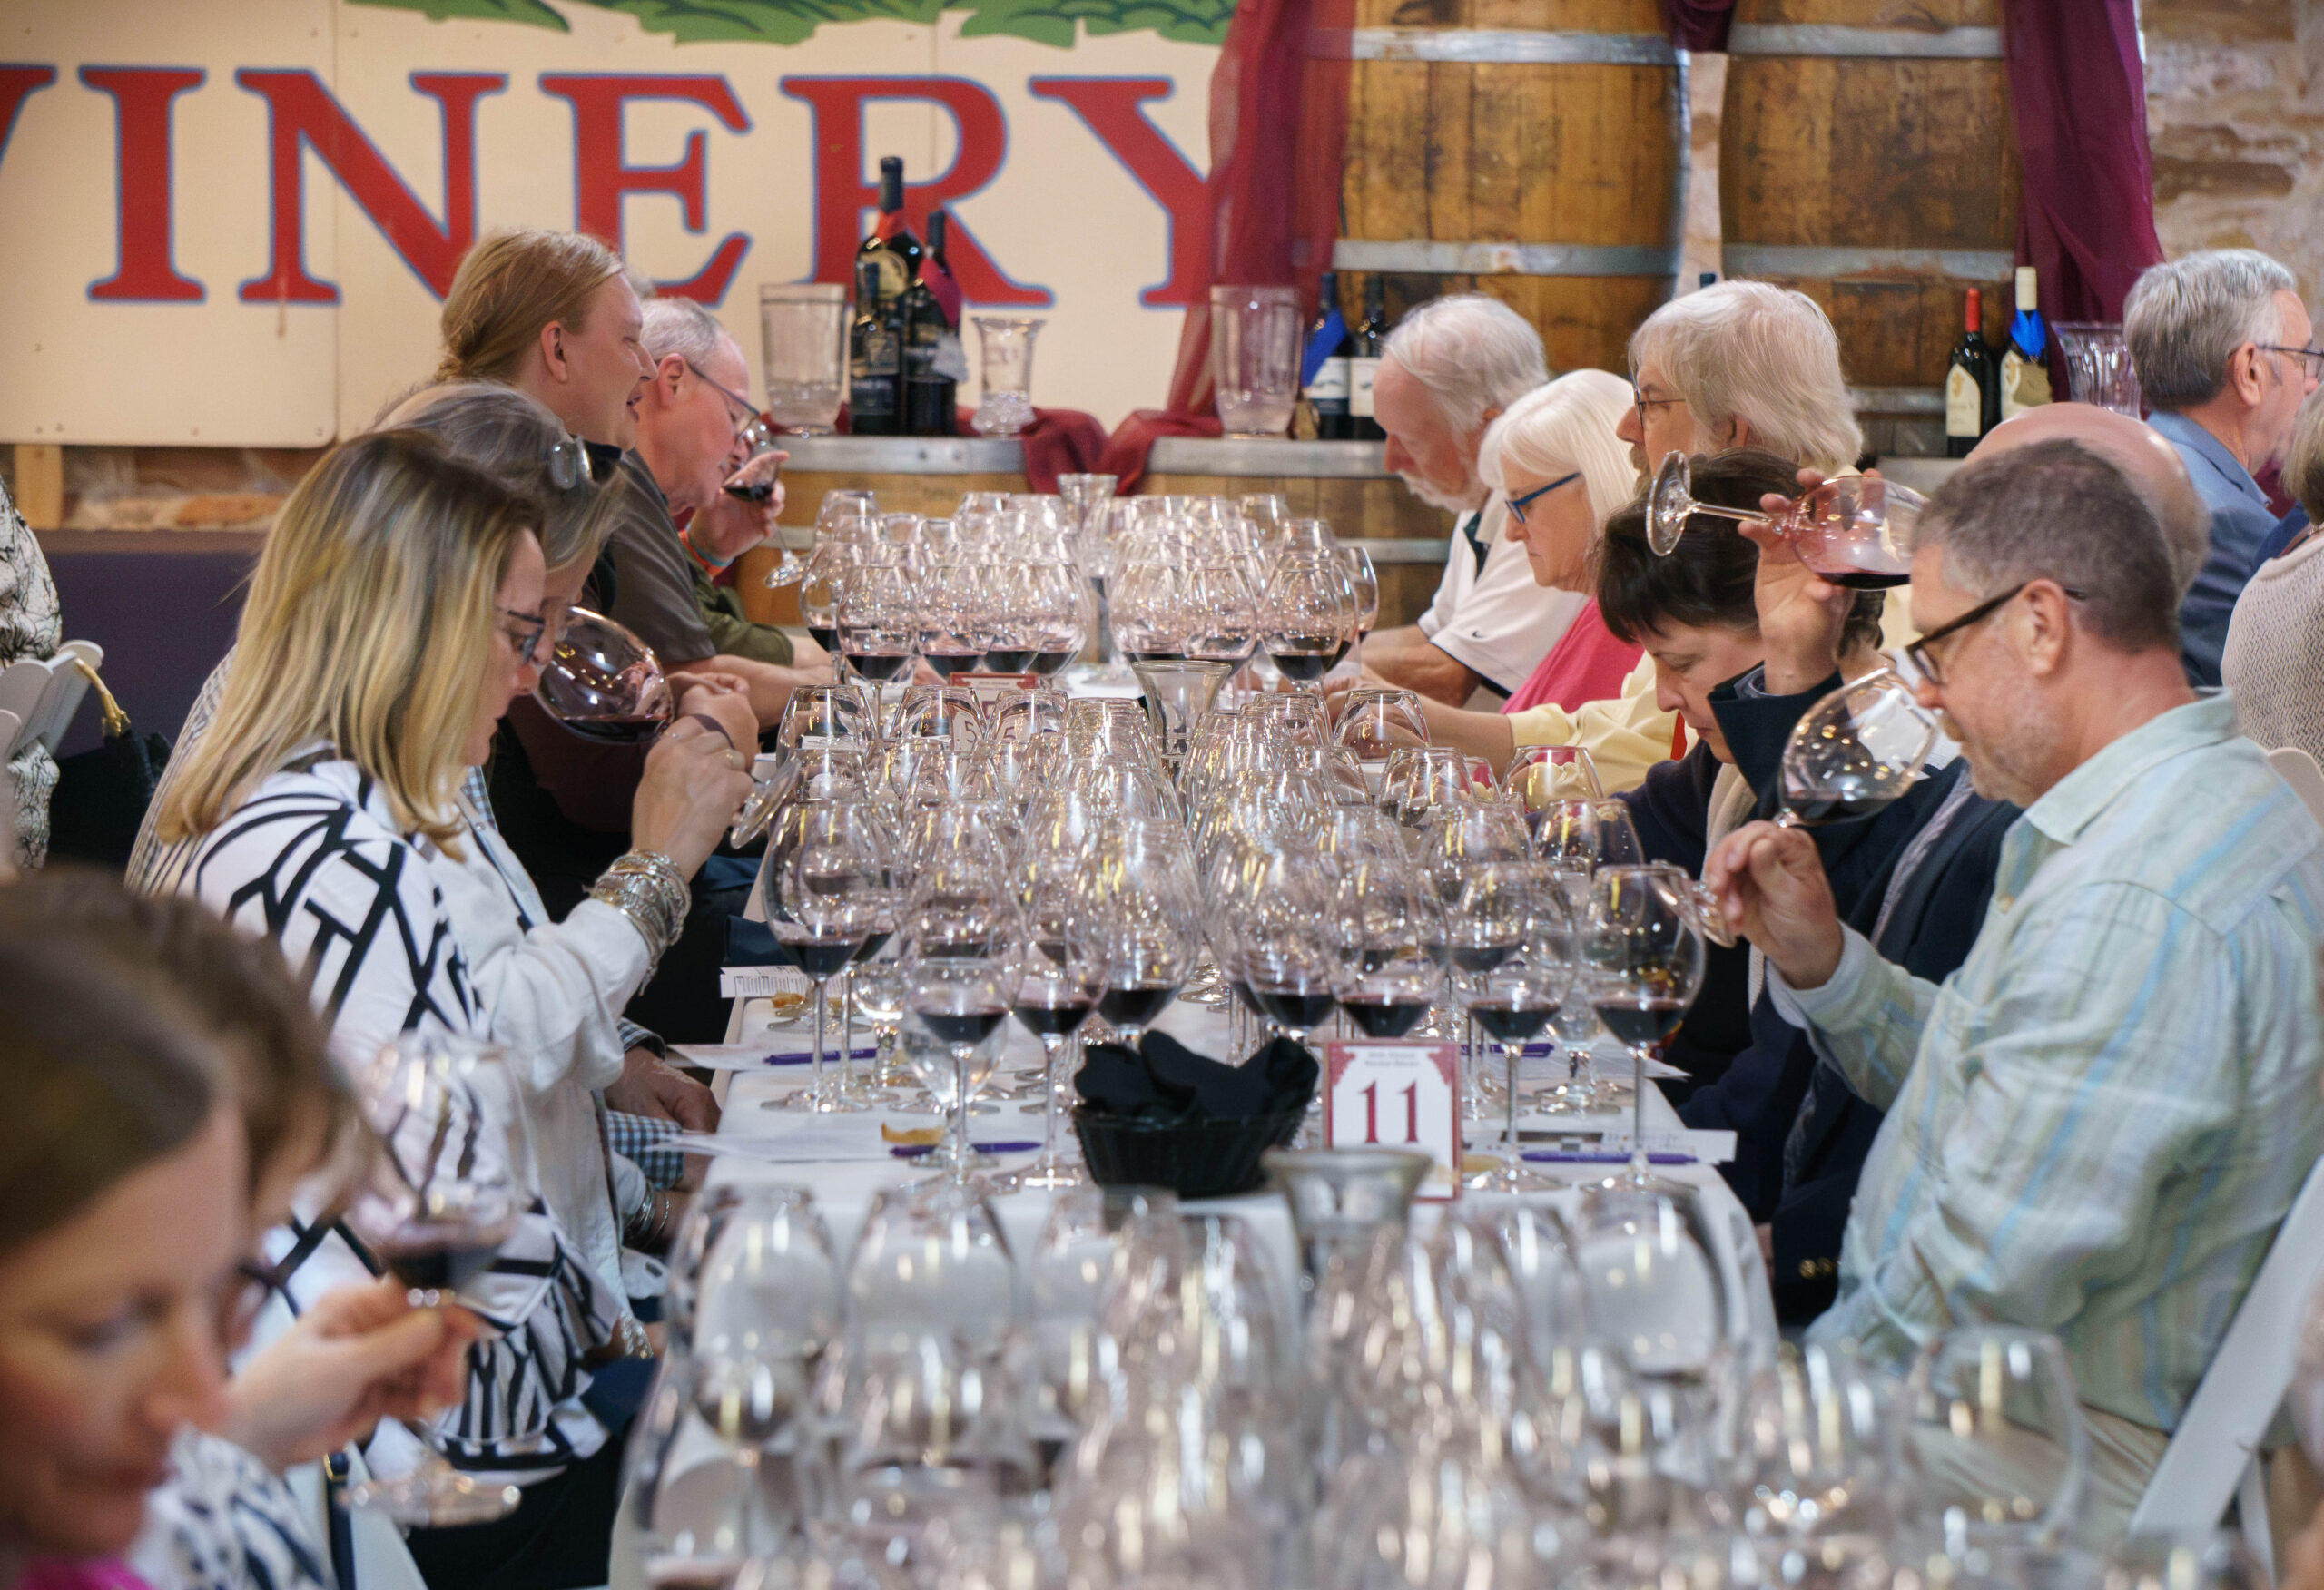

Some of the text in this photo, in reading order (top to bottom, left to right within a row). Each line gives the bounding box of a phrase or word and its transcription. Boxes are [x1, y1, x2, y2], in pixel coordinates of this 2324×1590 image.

[0, 64, 1216, 309] INERY
[964, 721, 977, 742] 5
[1358, 1079, 1419, 1144] 11
